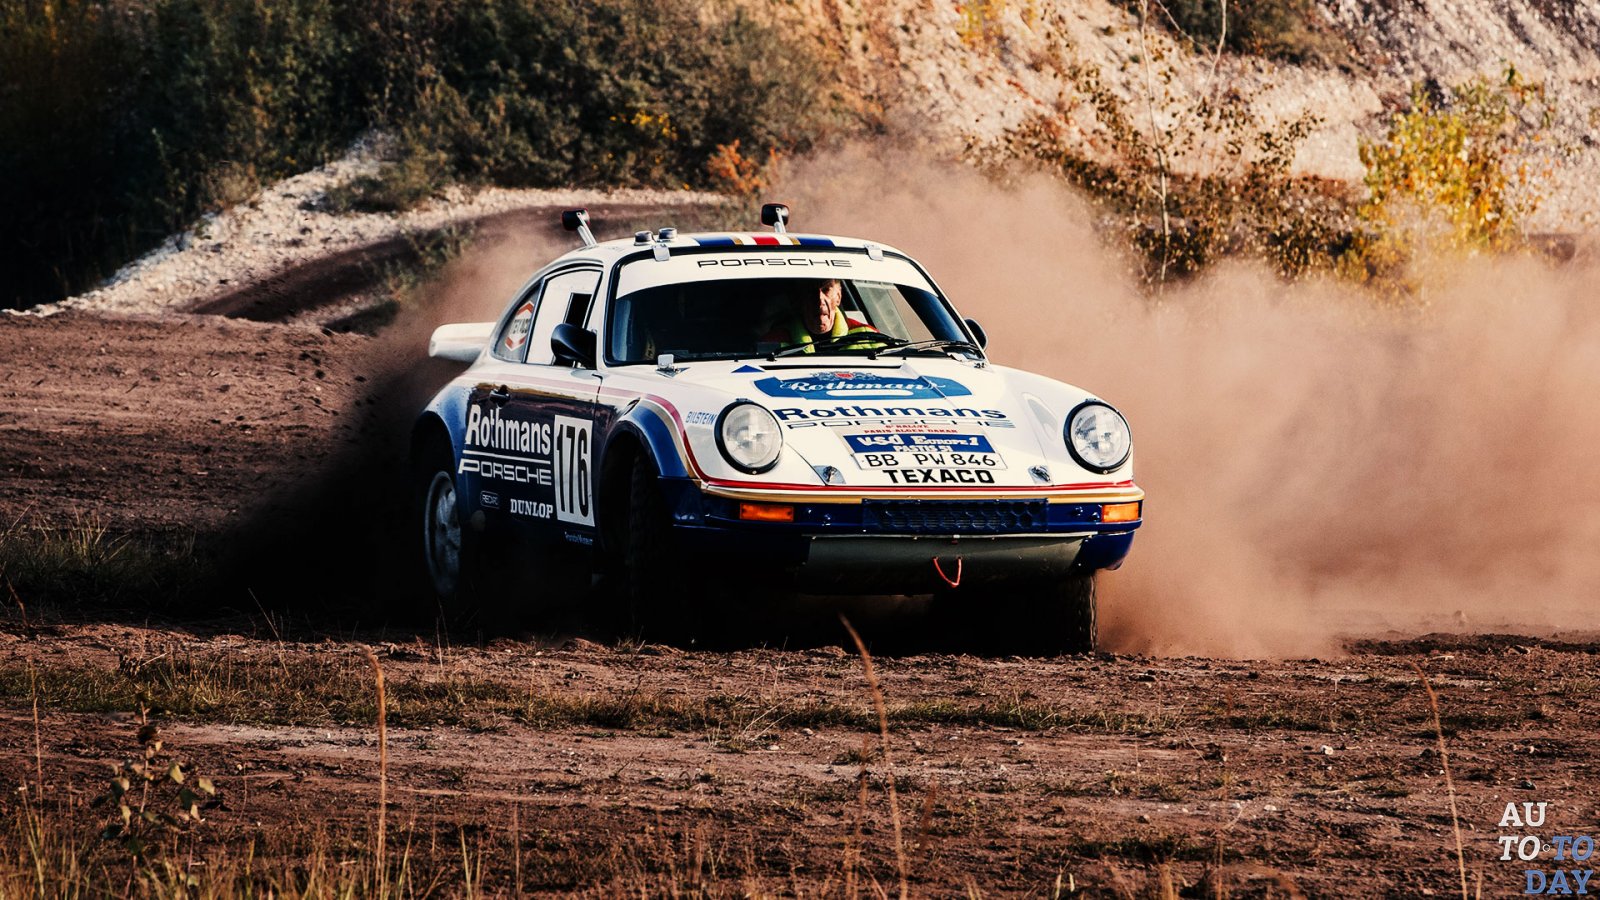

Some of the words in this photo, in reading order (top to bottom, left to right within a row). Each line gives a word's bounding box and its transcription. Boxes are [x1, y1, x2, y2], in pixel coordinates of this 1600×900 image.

[697, 258, 852, 269] PORSCHE
[685, 411, 718, 425] BILSTEIN
[772, 405, 1008, 420] Rothmans
[465, 404, 551, 456] Rothmans
[865, 453, 899, 467] BB
[912, 453, 946, 466] PW
[950, 453, 996, 467] 846
[458, 458, 552, 486] PORSCHE
[556, 422, 589, 518] 176
[882, 469, 996, 484] TEXACO
[510, 498, 553, 519] DUNLOP
